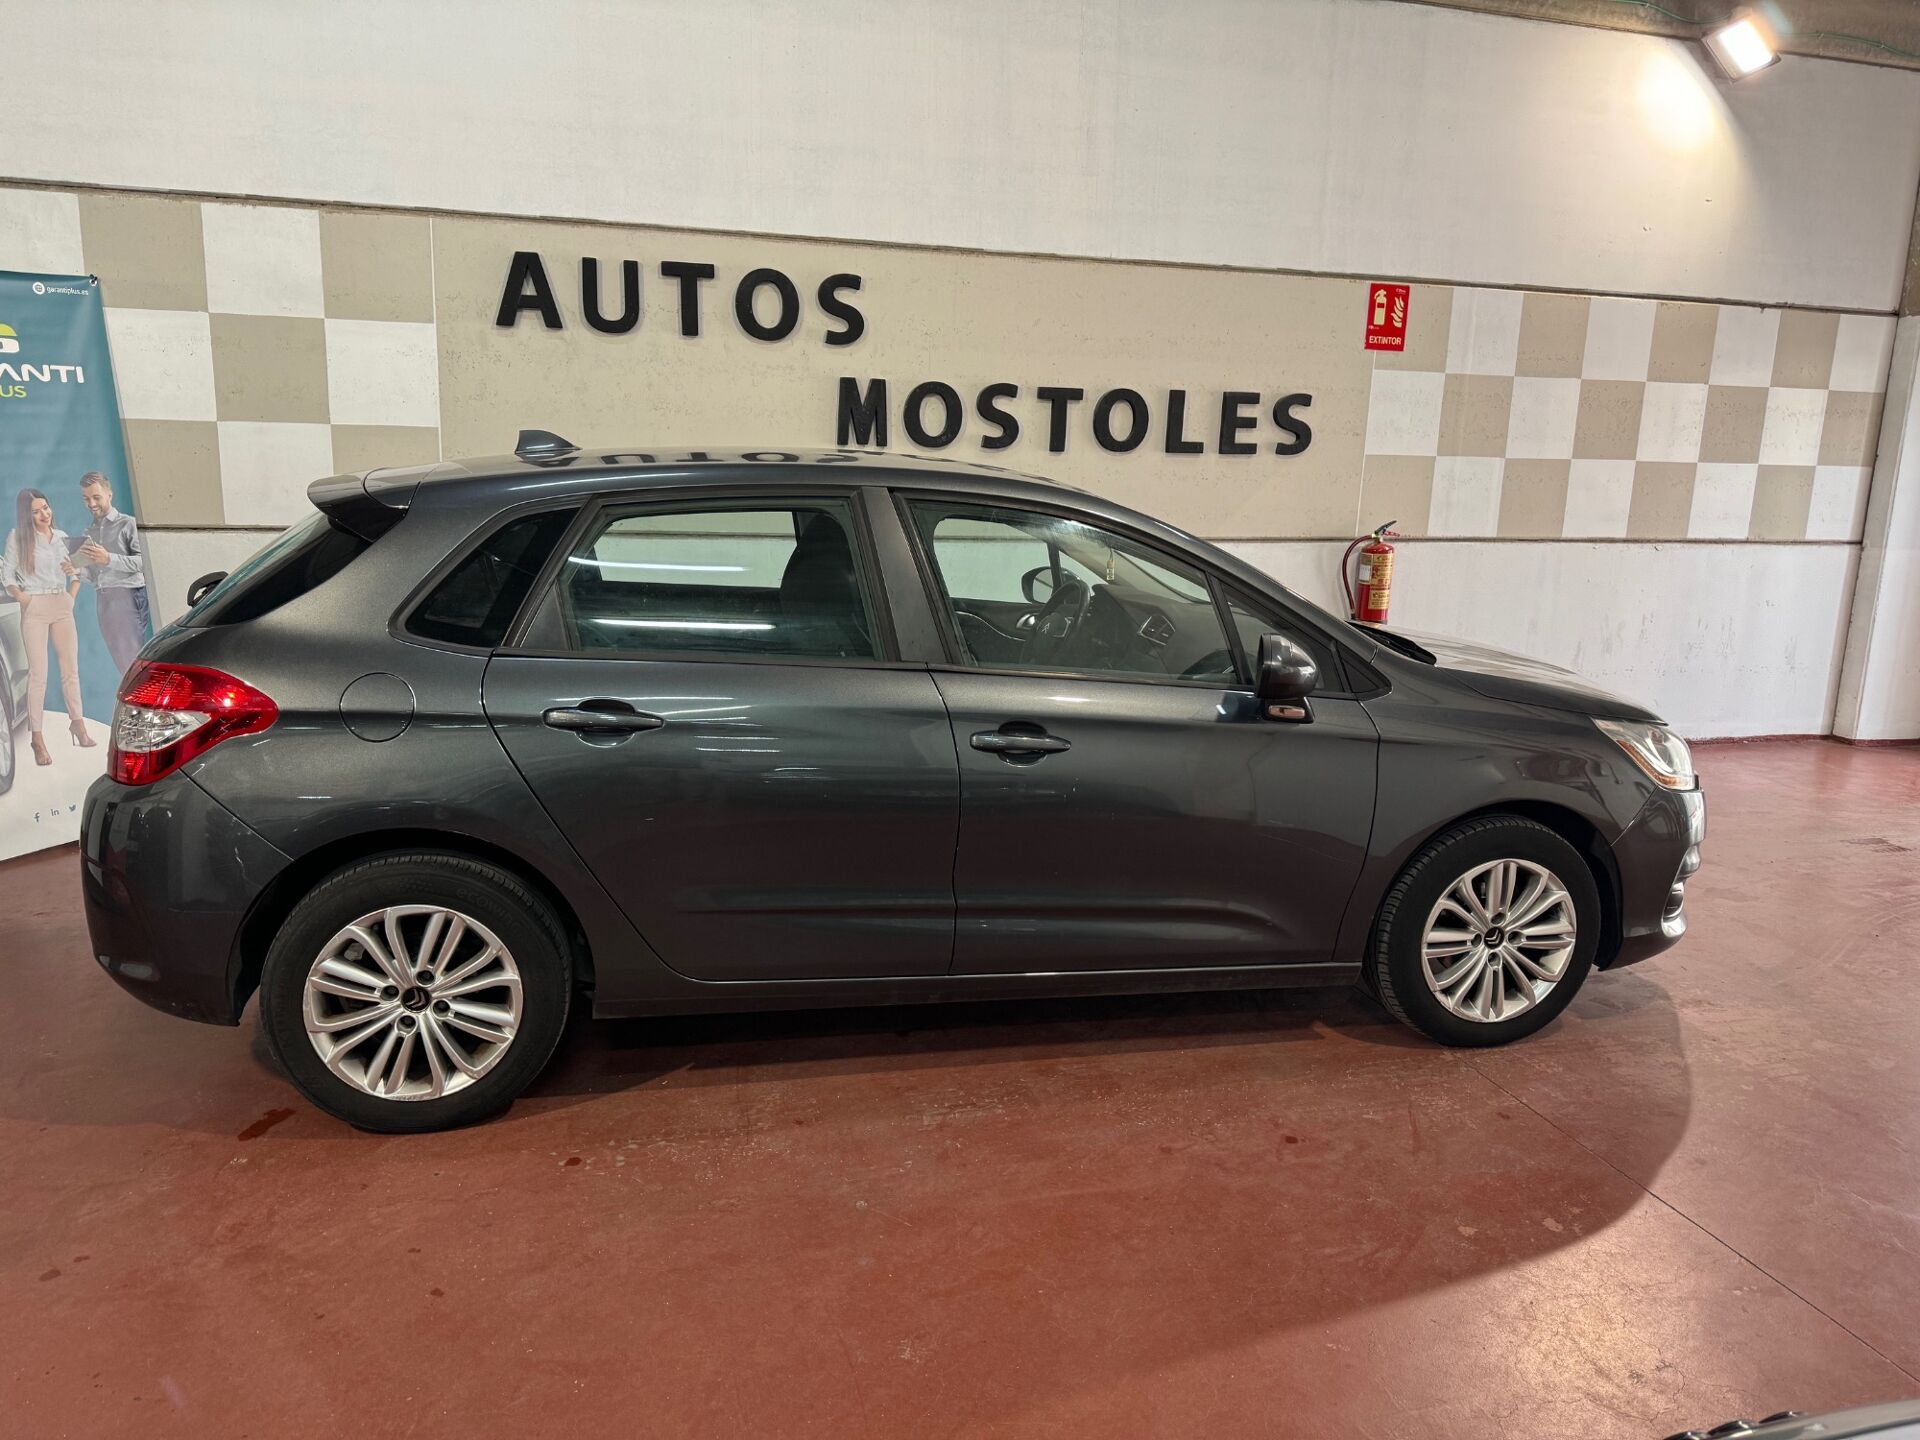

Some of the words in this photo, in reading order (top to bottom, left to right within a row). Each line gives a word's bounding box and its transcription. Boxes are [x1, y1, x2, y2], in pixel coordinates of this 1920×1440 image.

[46, 286, 89, 295] garantiplus.es
[496, 251, 865, 346] AUTOS
[1369, 335, 1402, 345] EXTINTOR
[837, 377, 1313, 456] MOSTOLES
